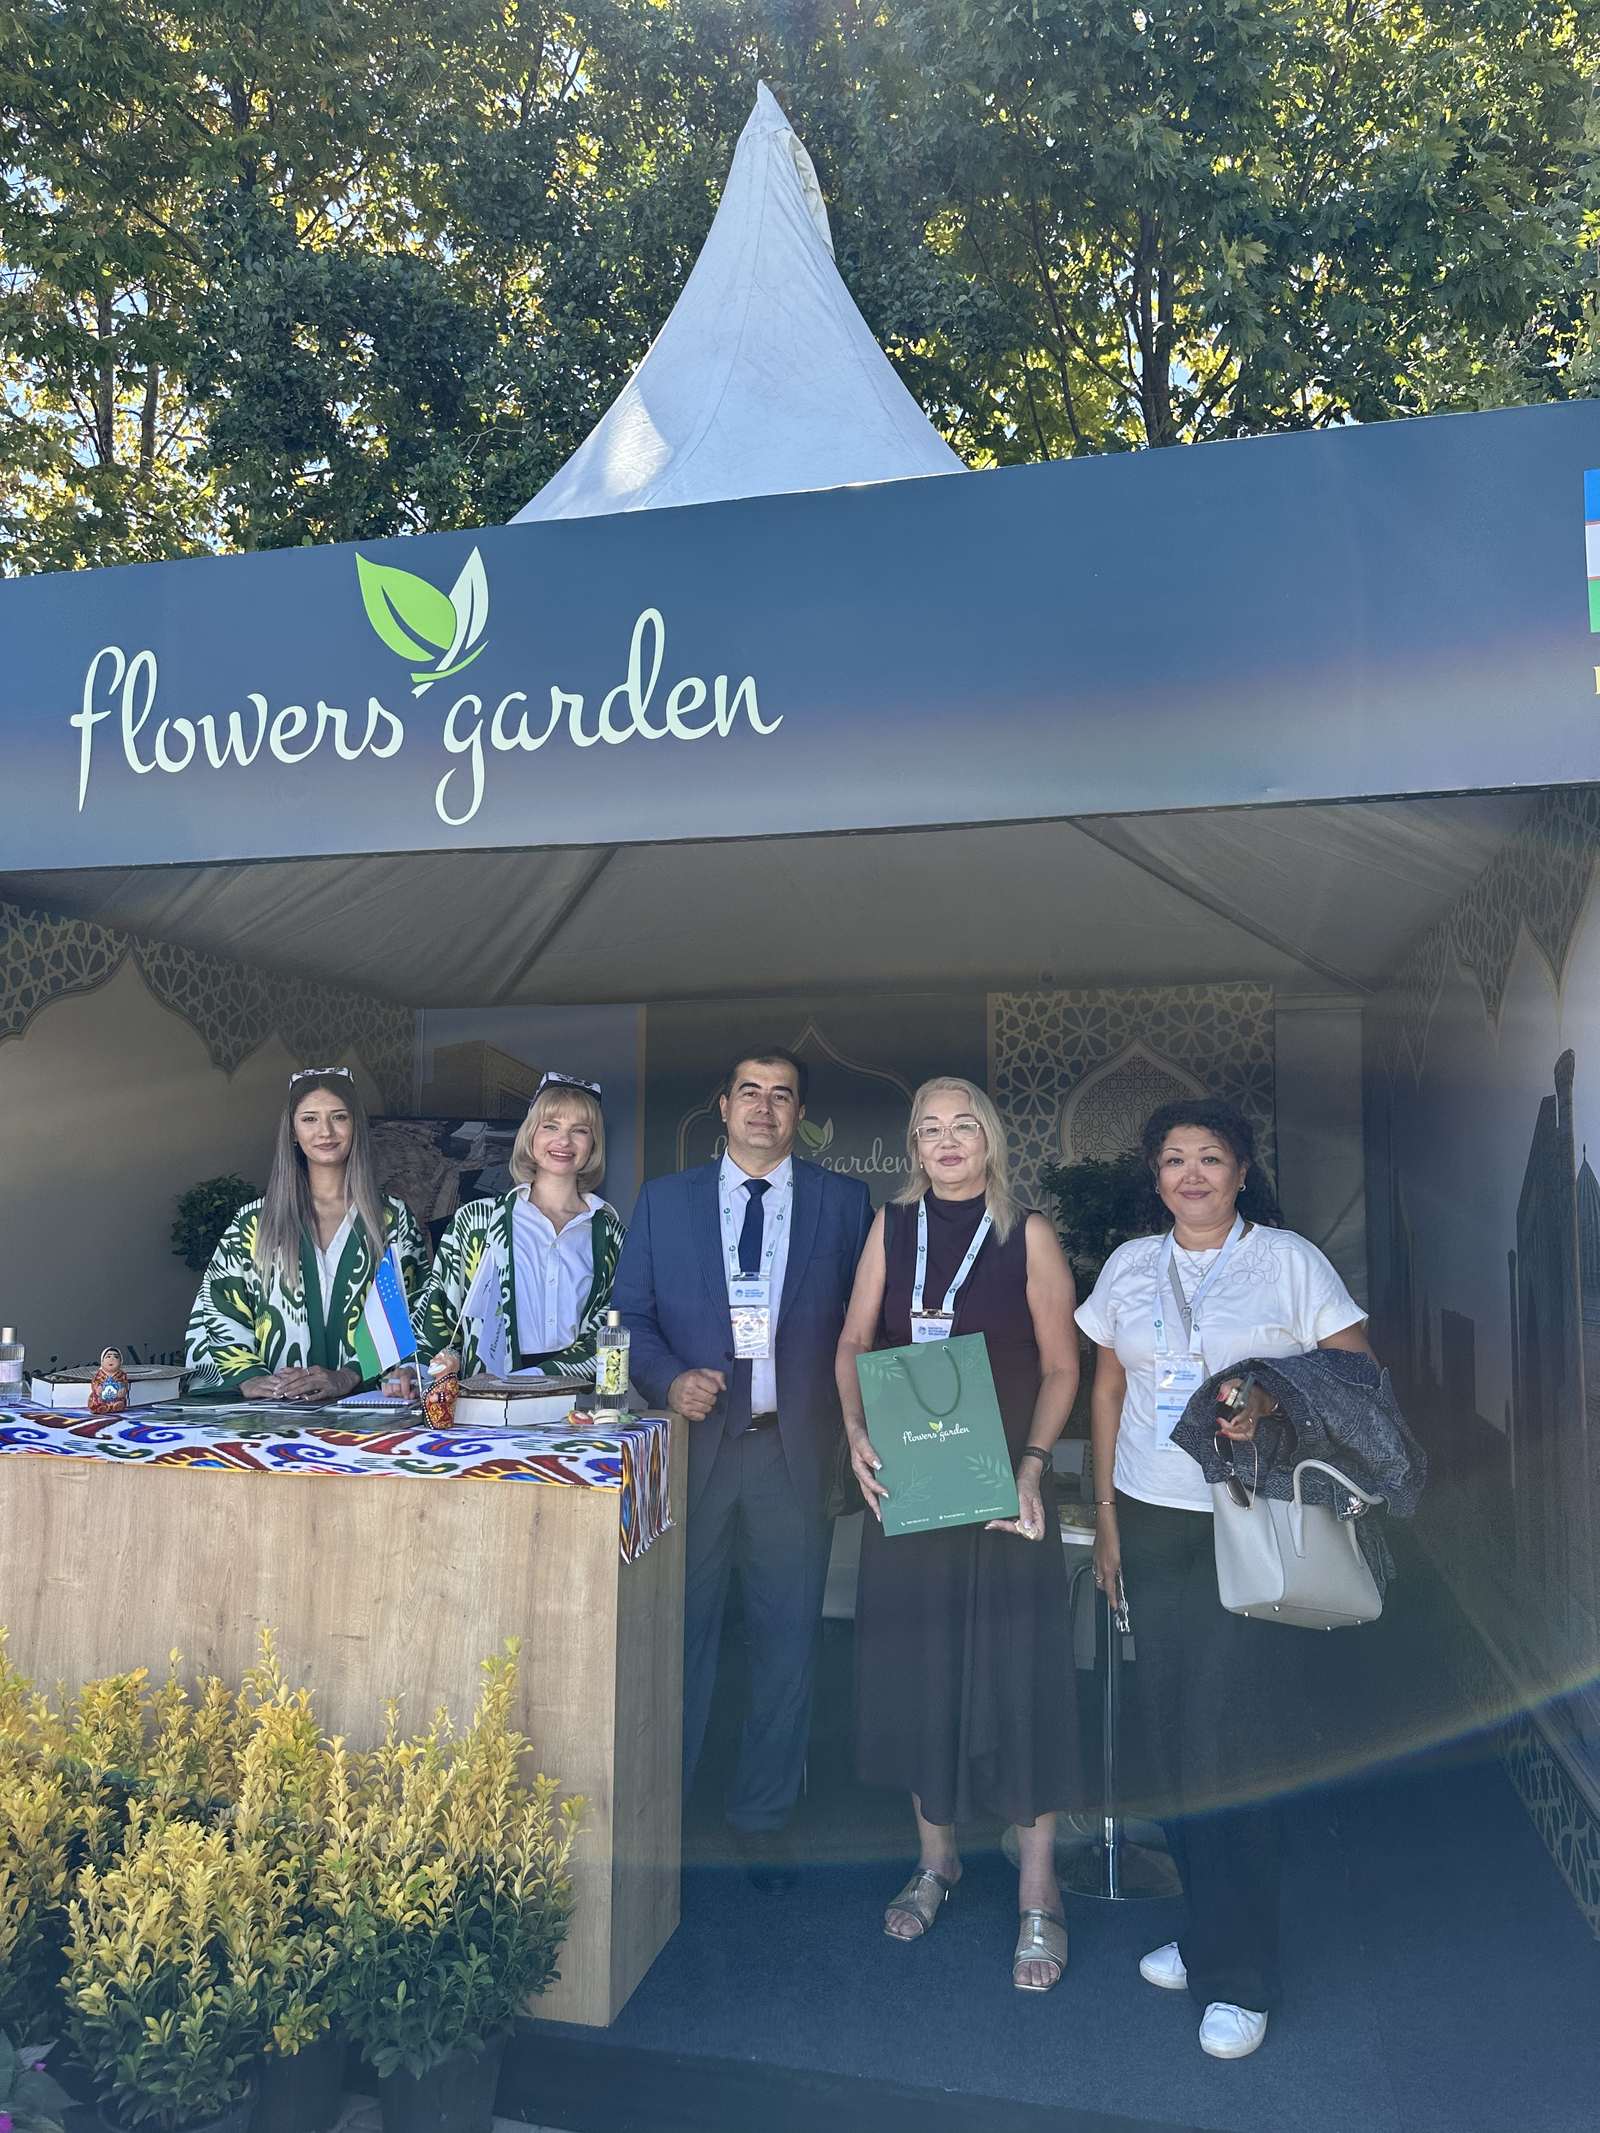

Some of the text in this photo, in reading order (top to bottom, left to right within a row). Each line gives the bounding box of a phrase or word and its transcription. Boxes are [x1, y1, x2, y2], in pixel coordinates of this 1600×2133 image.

[70, 607, 784, 826] flowers garden
[903, 1423, 970, 1446] flowers garden
